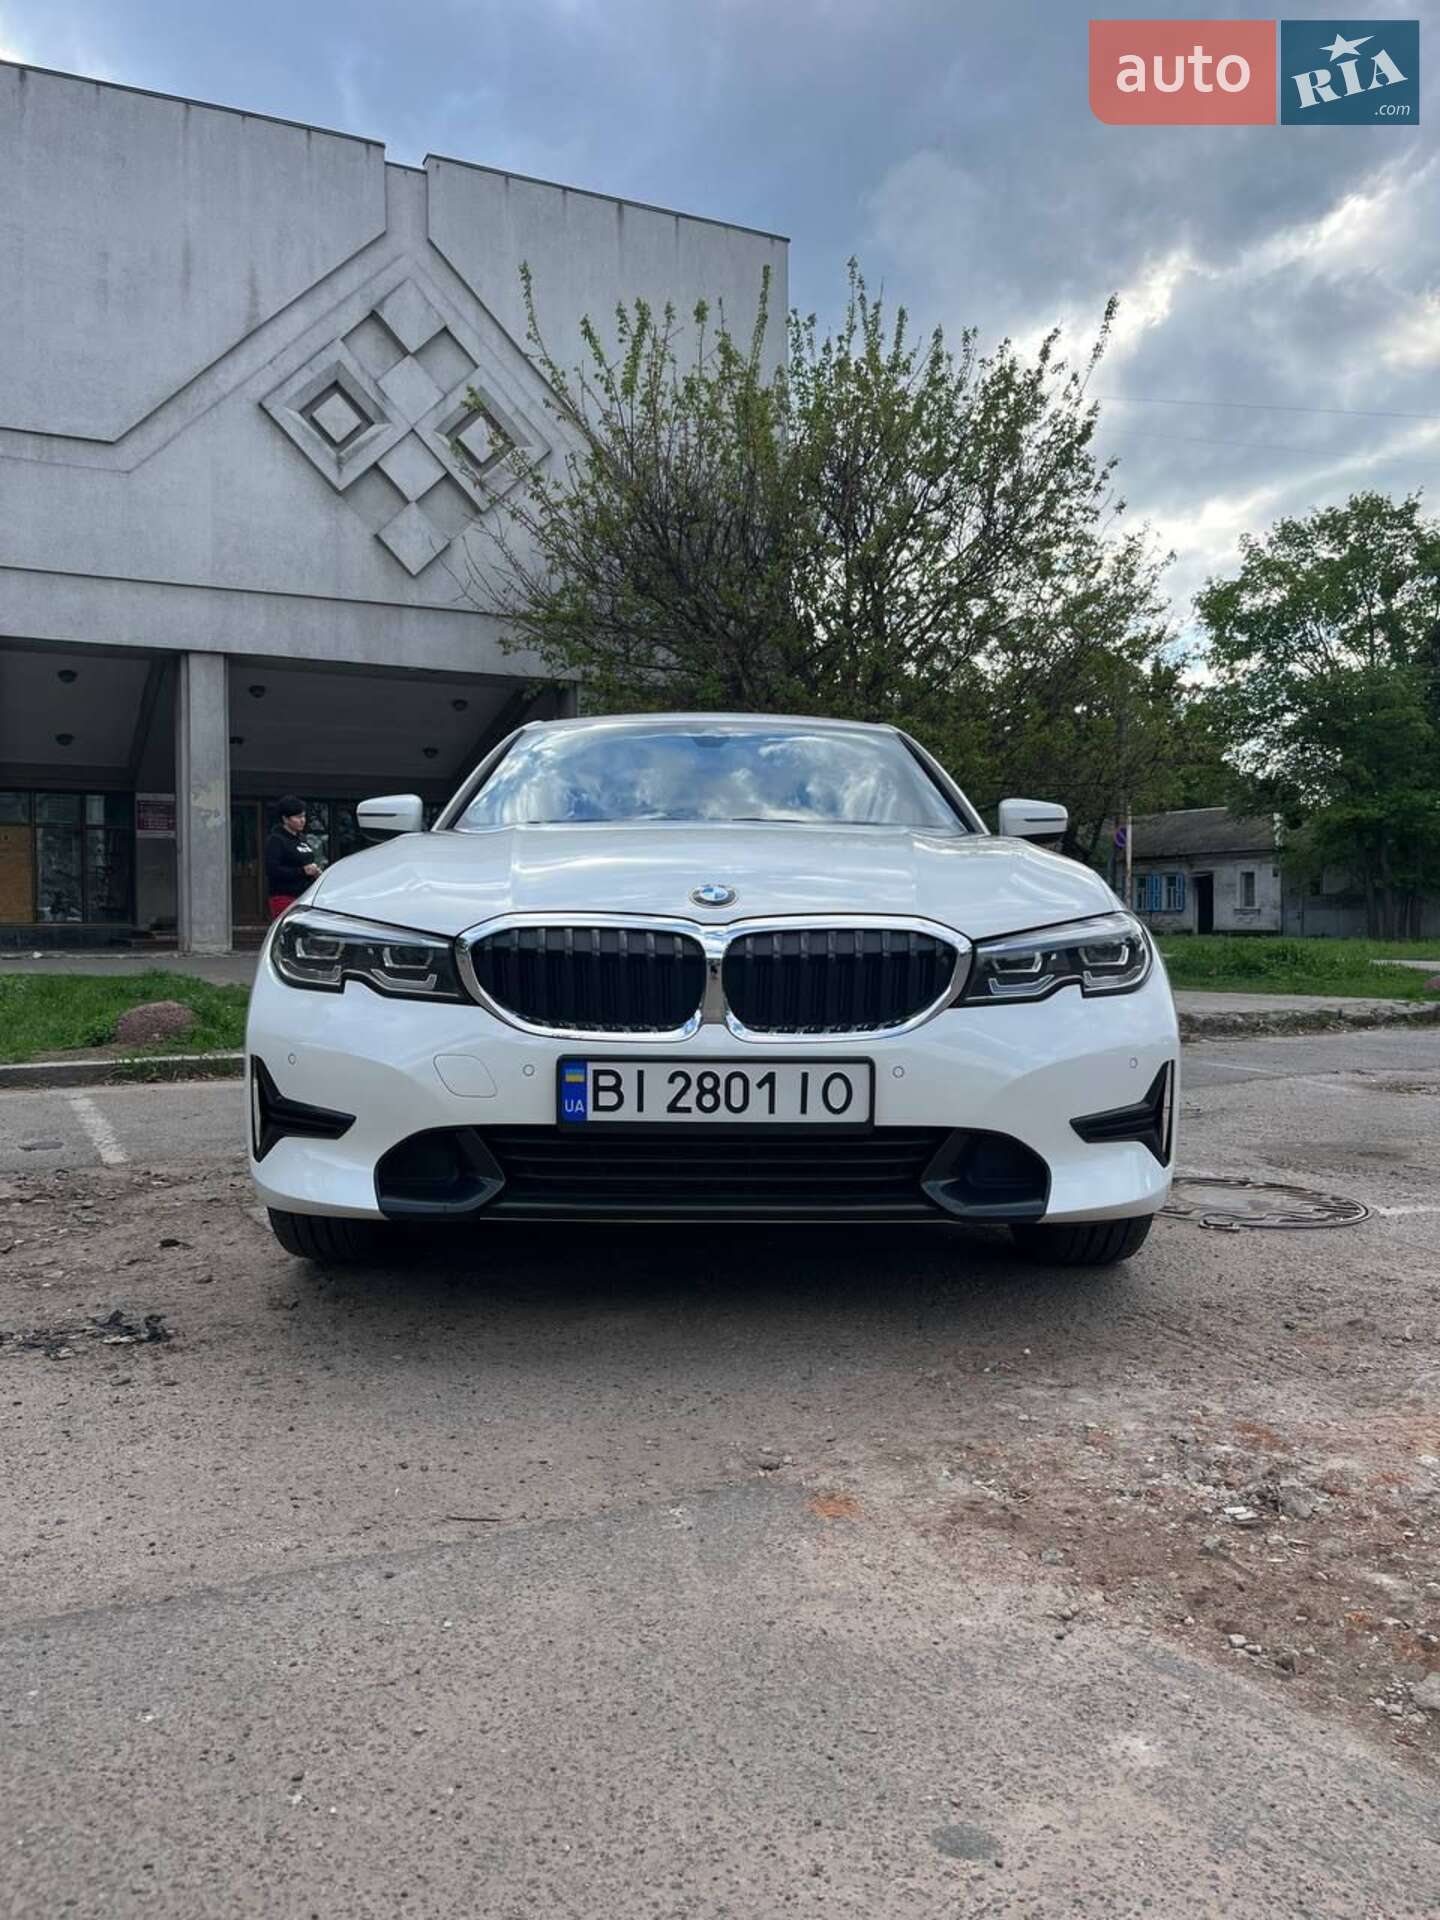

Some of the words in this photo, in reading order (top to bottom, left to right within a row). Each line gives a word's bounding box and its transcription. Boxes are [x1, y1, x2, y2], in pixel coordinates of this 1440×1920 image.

[565, 1099, 585, 1113] UA
[592, 1069, 645, 1112] BI
[666, 1070, 776, 1114] 2801
[800, 1071, 853, 1115] IO
